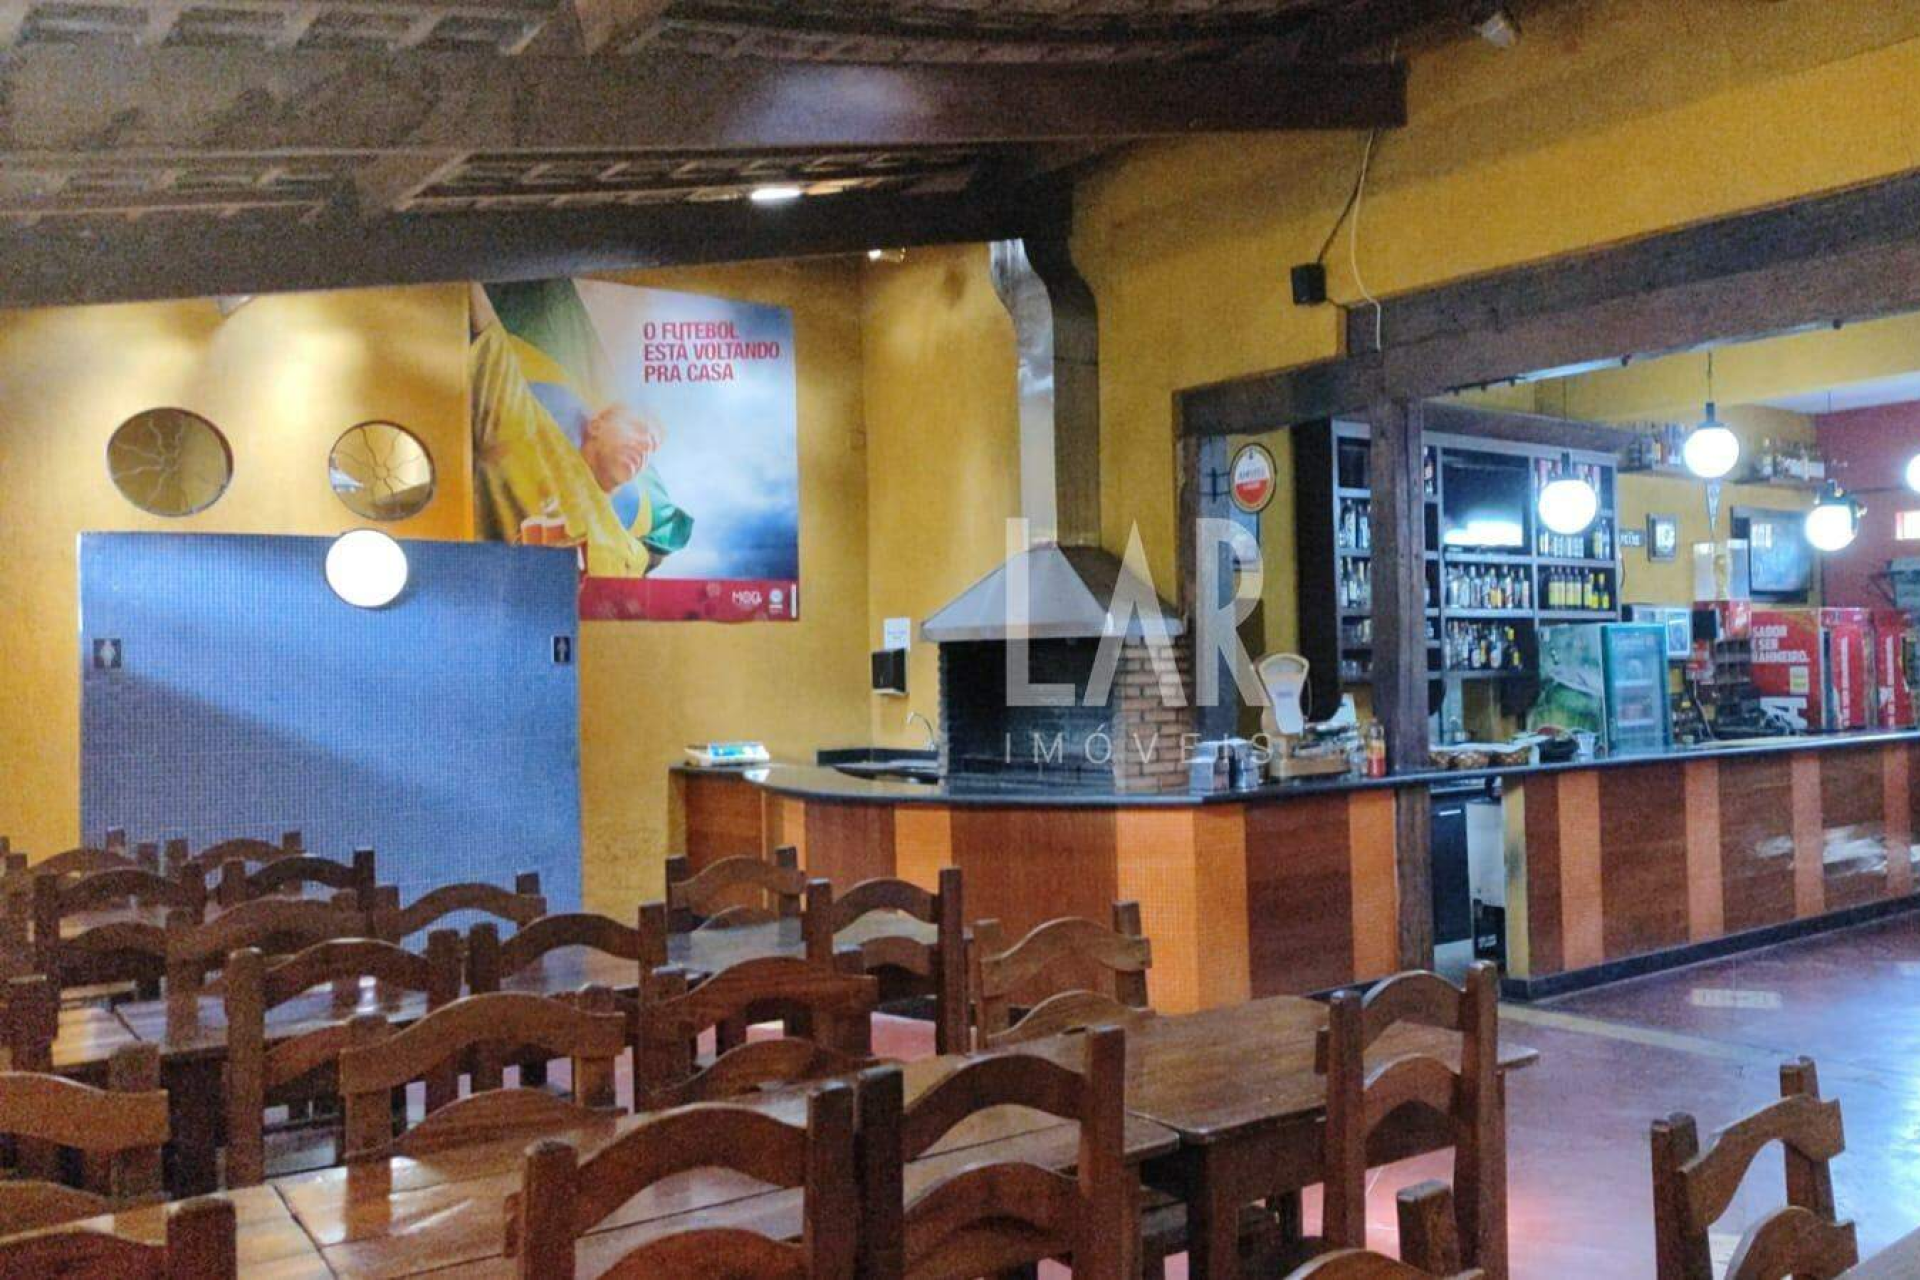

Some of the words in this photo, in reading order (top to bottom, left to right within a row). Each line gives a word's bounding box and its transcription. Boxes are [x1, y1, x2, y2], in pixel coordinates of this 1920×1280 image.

[644, 322, 656, 340] O
[661, 321, 741, 341] FUTEBOL
[693, 341, 781, 360] VOLTANDO
[644, 364, 682, 383] PRA
[686, 362, 734, 382] CASA
